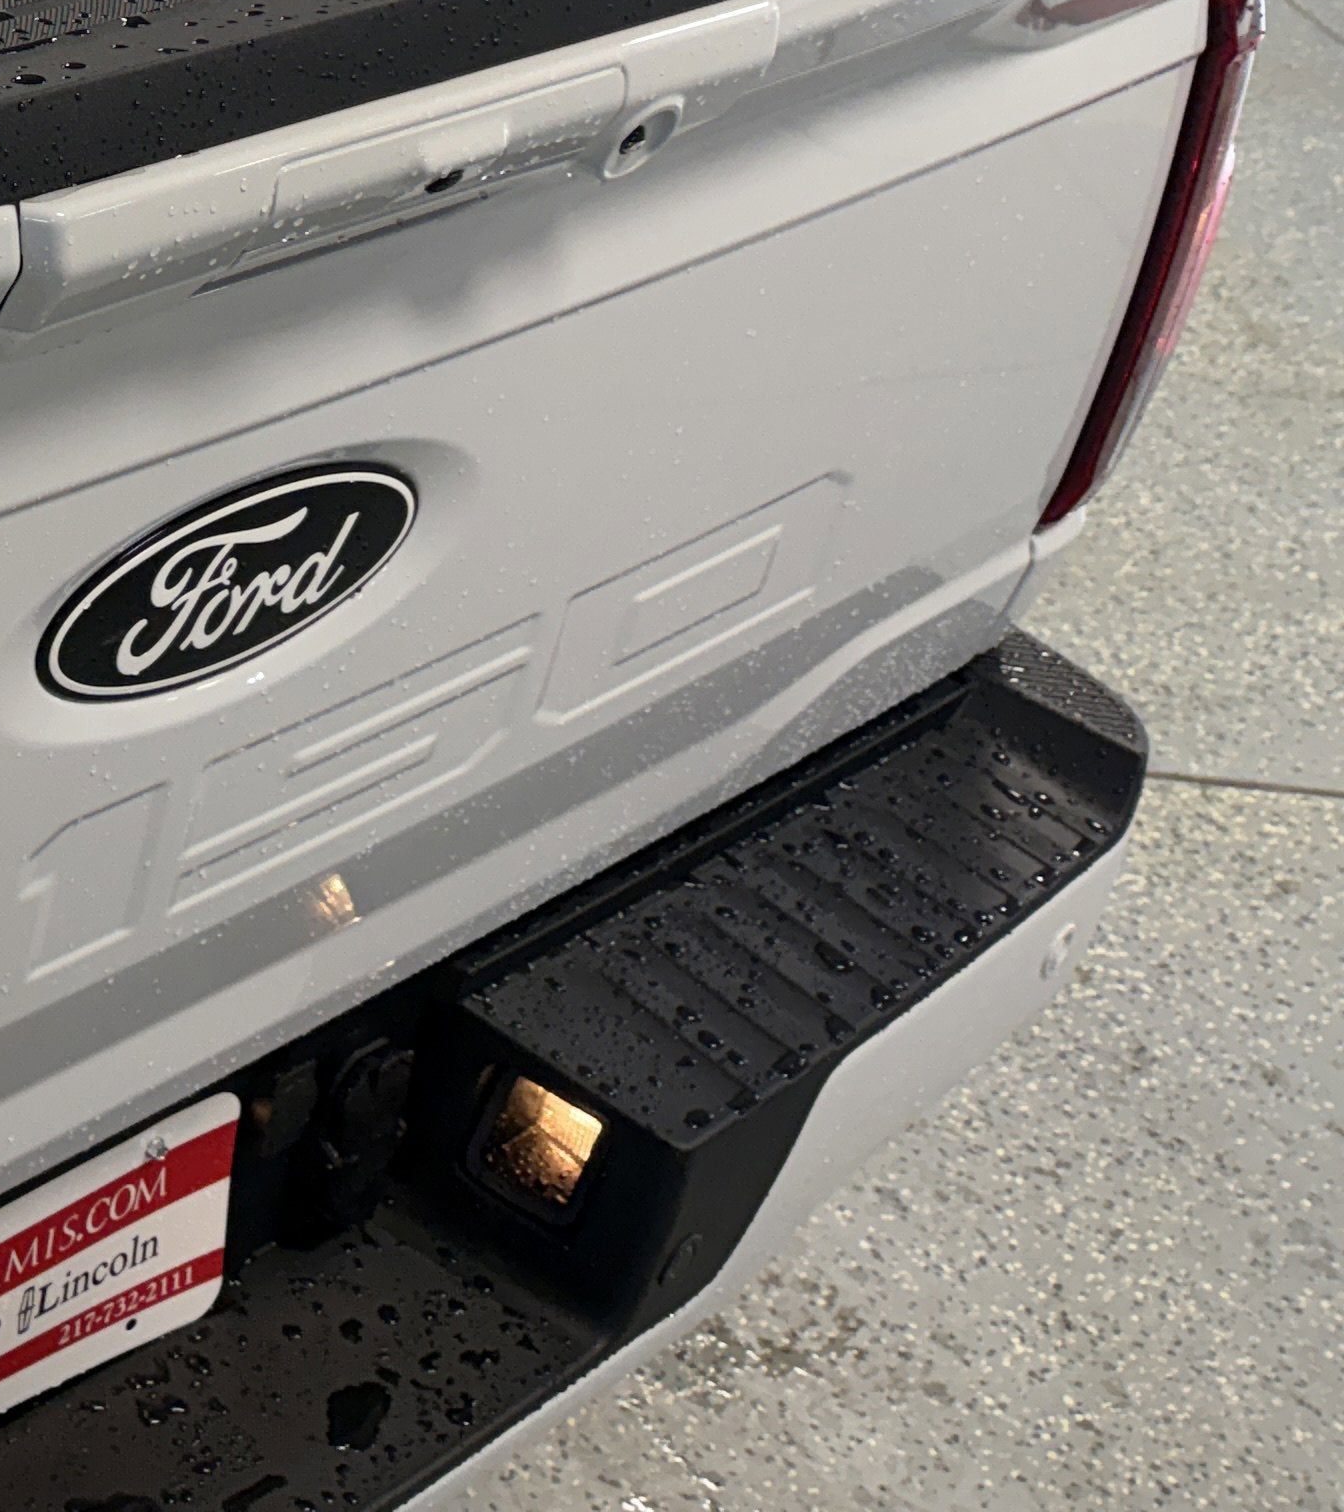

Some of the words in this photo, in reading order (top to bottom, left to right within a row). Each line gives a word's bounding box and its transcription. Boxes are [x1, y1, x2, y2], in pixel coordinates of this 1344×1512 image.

[115, 505, 360, 677] Ford
[33, 1234, 160, 1319] Lincoln
[57, 1266, 194, 1346] 217-732-2111
